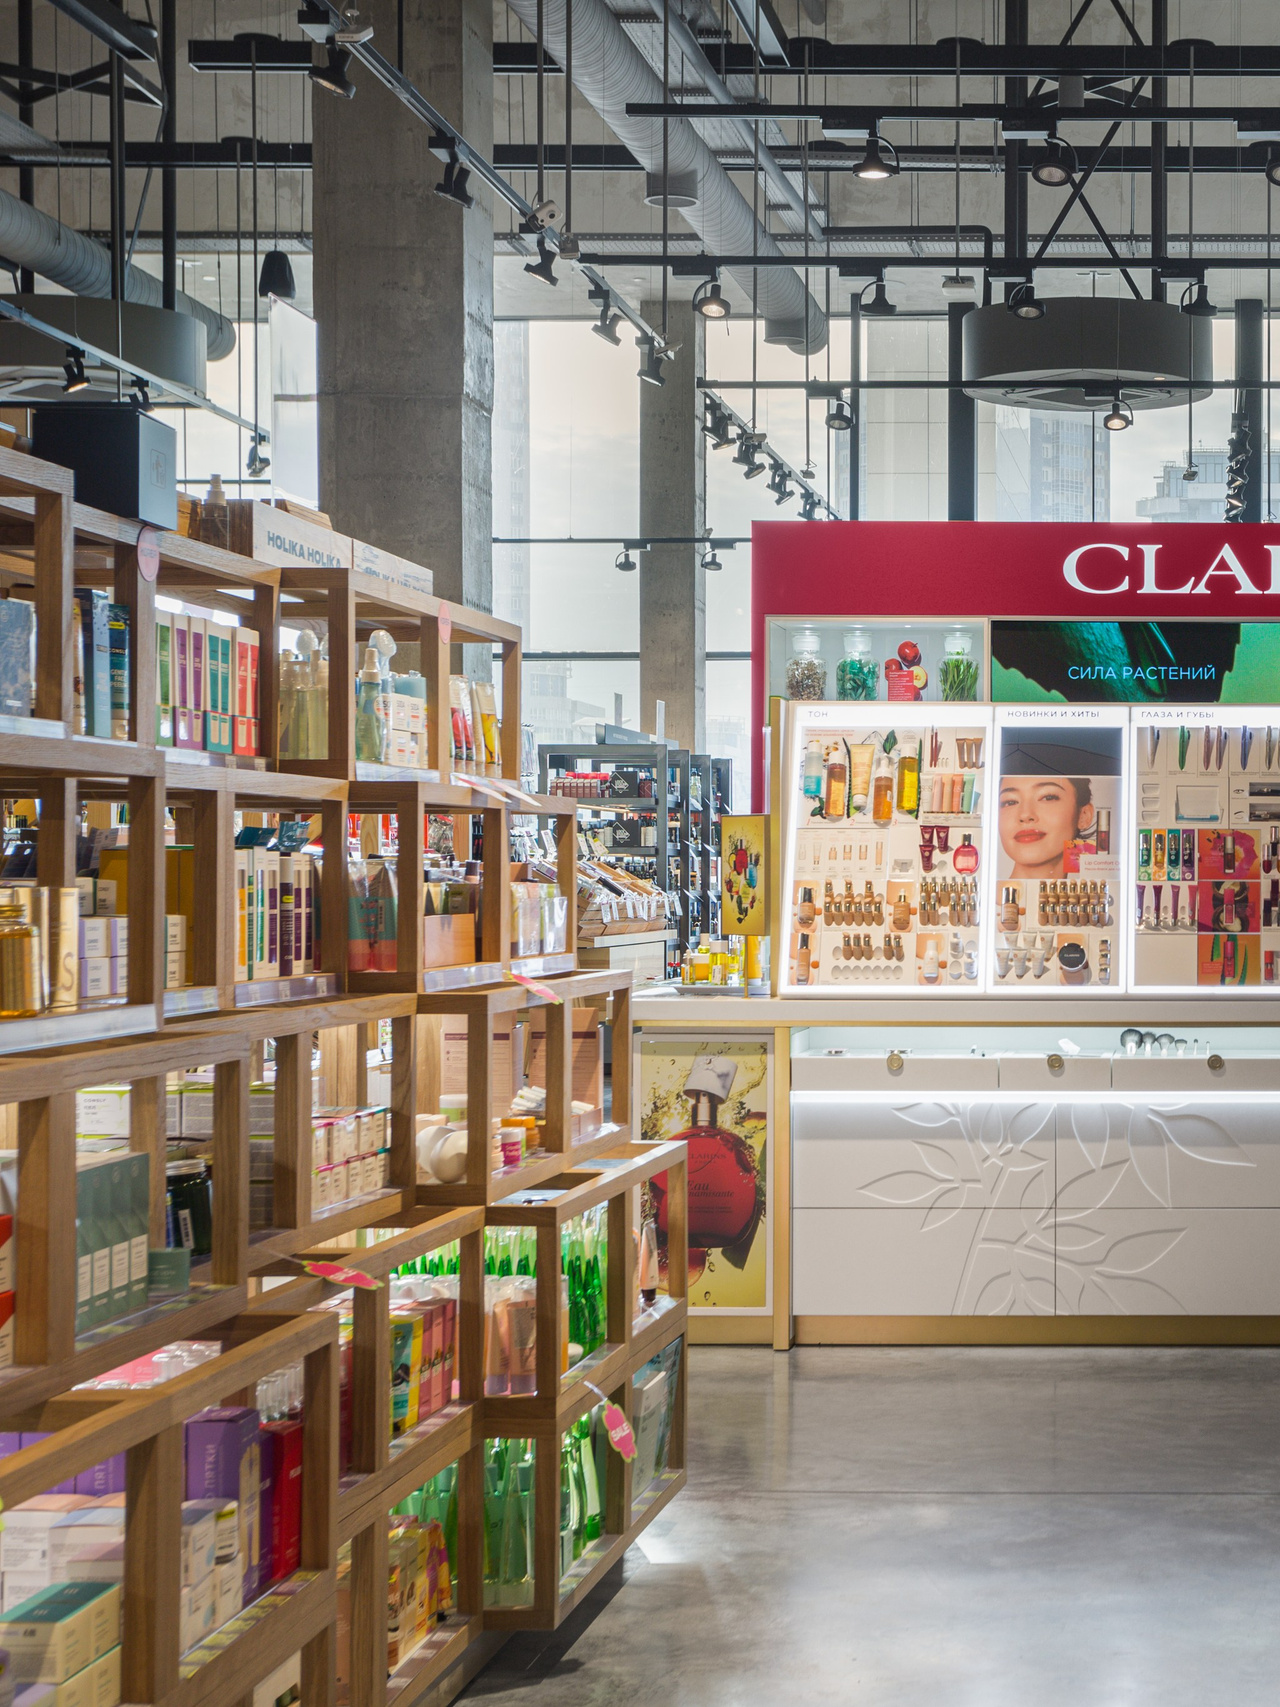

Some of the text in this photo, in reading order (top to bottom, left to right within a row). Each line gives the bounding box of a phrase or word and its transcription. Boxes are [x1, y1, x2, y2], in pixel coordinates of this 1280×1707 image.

[267, 531, 341, 568] HOLIKA HOLIKA
[1068, 664, 1216, 680] СИЛА РАСТЕНИЙ
[808, 710, 828, 718] ТОН
[1007, 710, 1100, 718] НОВИНКИ И ХИТЫ
[1141, 711, 1174, 719] ГЛАЗА
[1186, 711, 1215, 719] ГУБЫ
[610, 1421, 631, 1442] SALE
[204, 1444, 217, 1489] ПЯТКИ
